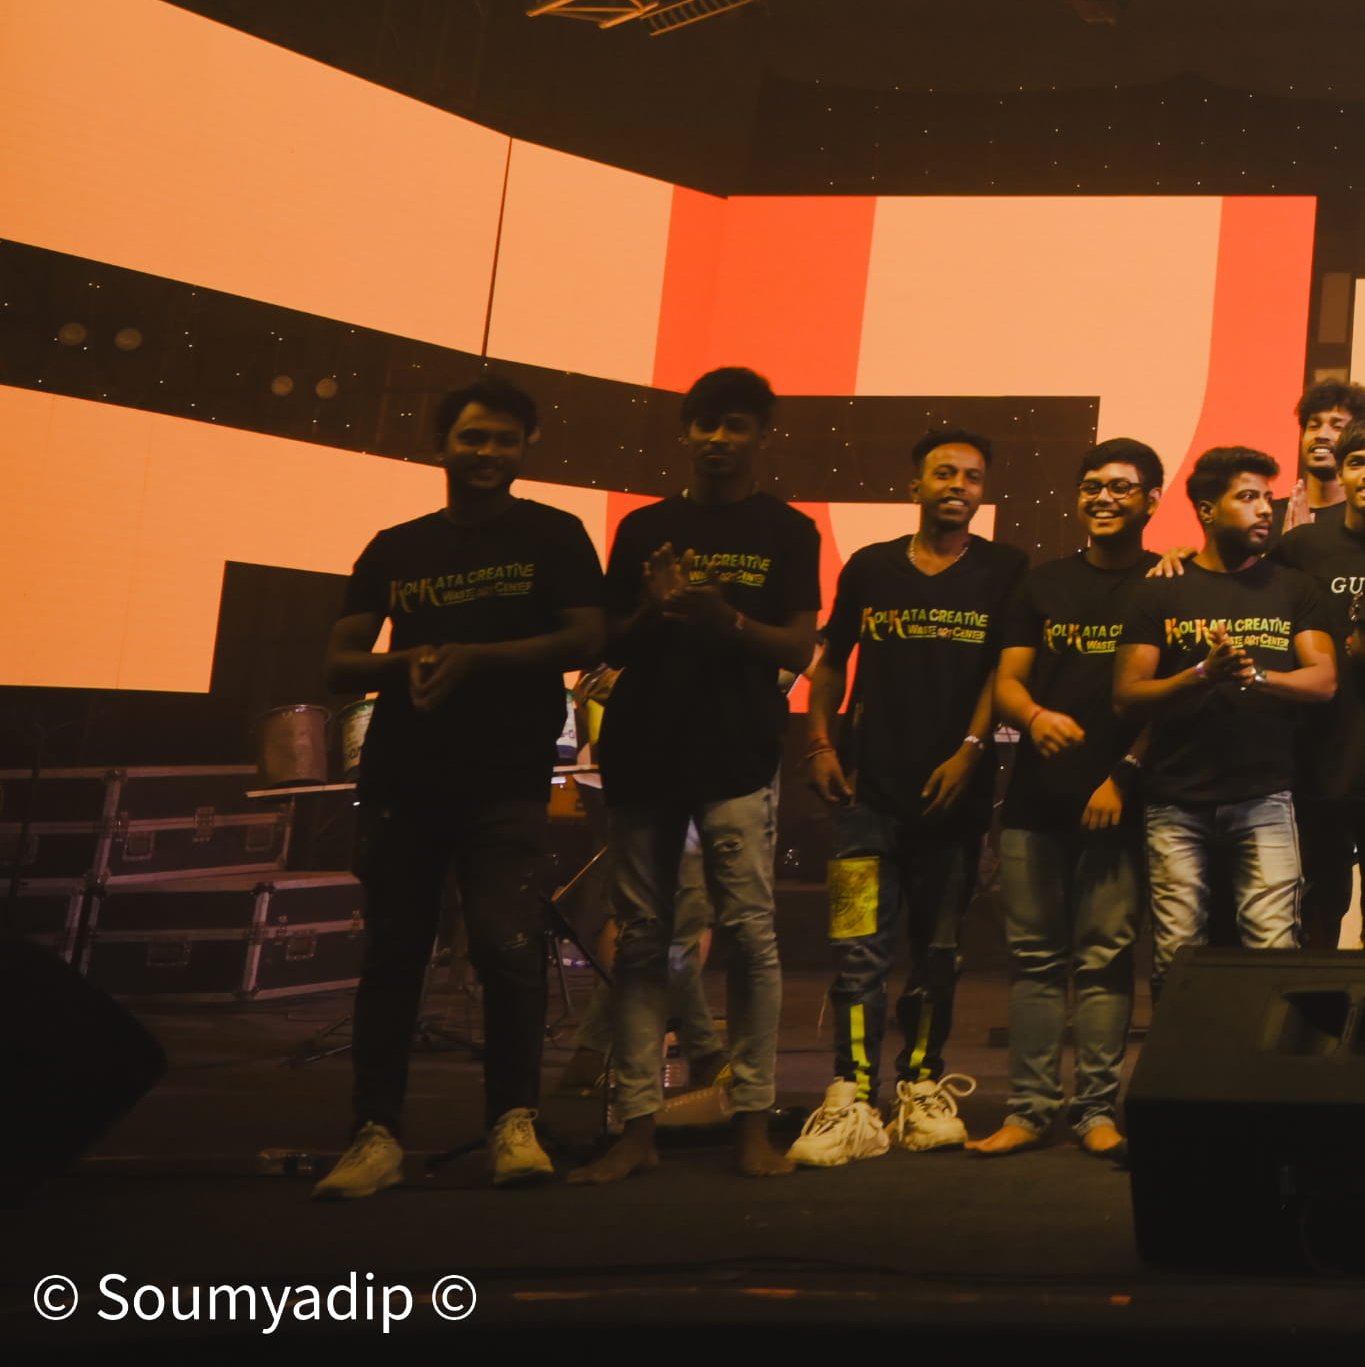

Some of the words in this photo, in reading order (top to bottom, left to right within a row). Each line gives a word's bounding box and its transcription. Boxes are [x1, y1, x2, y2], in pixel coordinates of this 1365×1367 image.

[389, 574, 464, 613] KOLKATA
[467, 562, 535, 583] CREATIVE
[861, 607, 927, 641] KOLKATA
[929, 608, 990, 628] CREATIVE
[907, 625, 937, 636] WASTE
[1235, 617, 1292, 635] CREATIVE
[1260, 633, 1290, 649] CENTER
